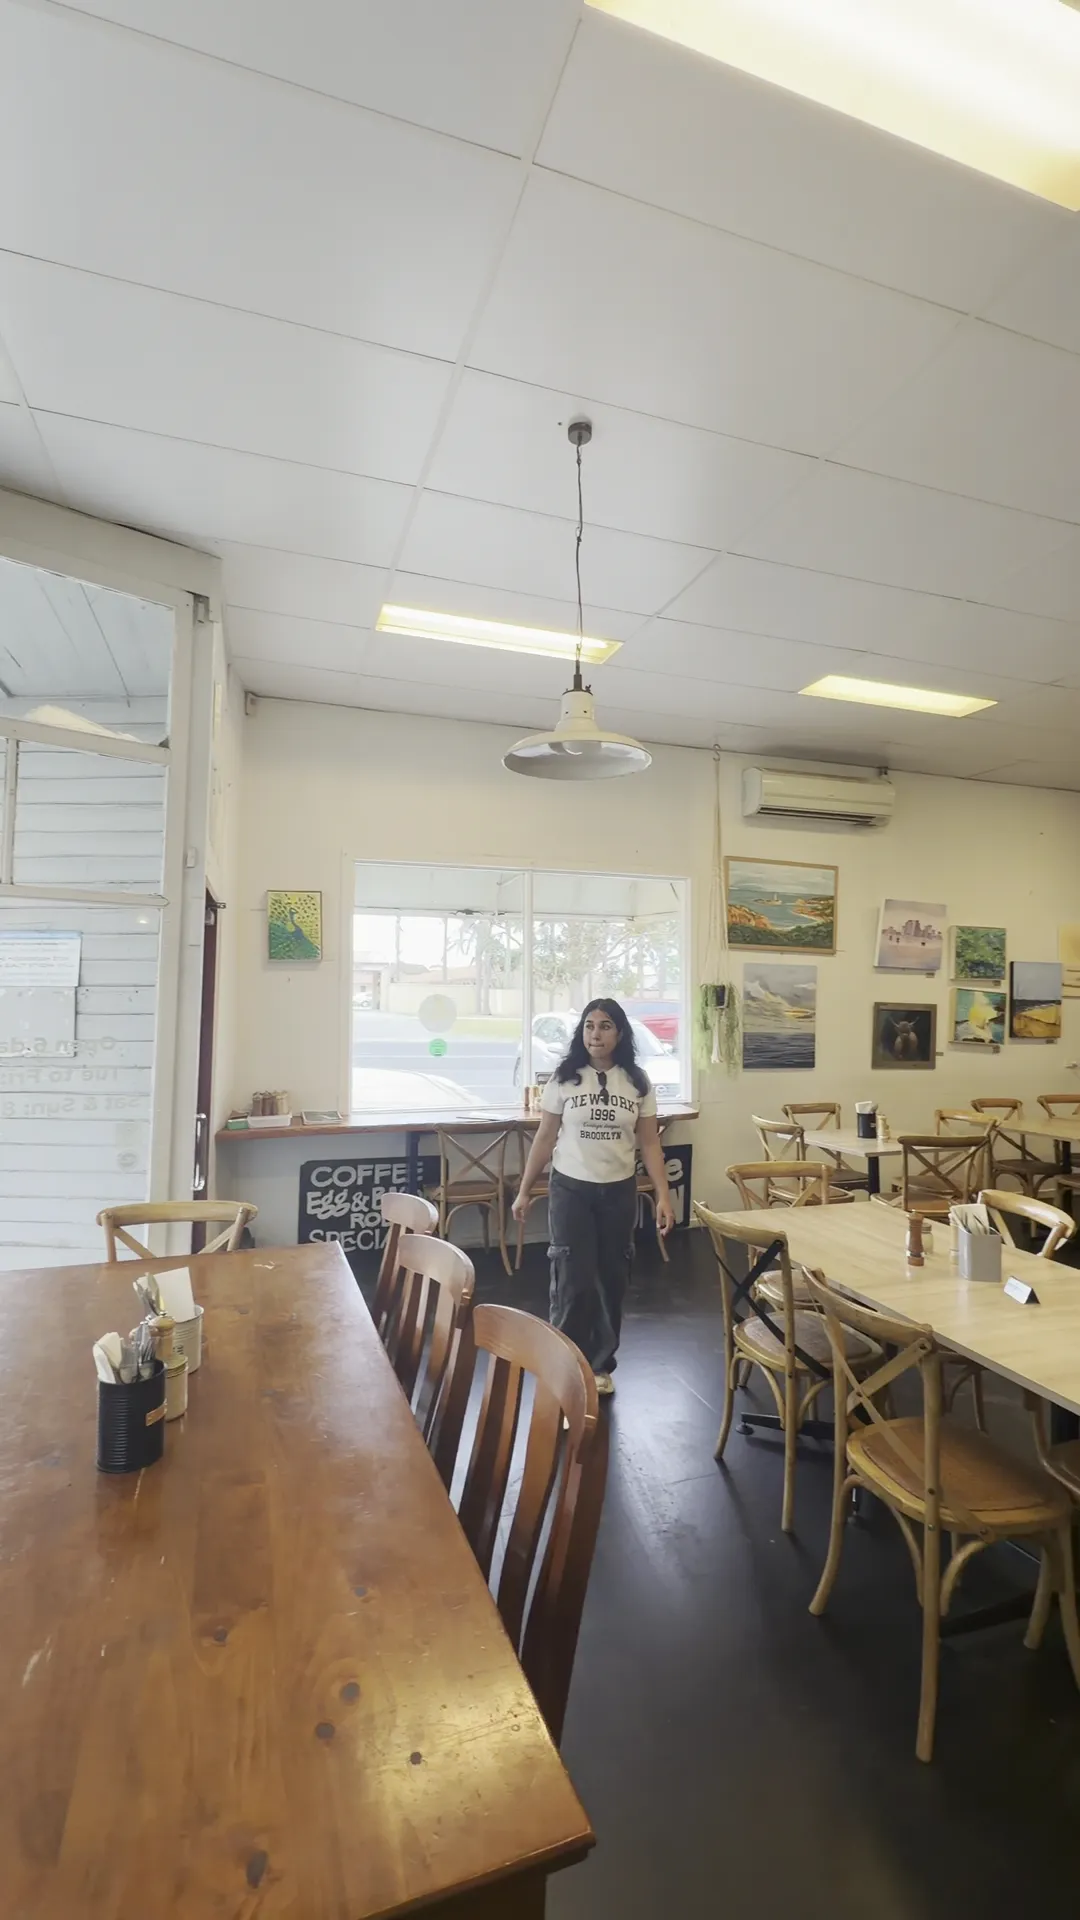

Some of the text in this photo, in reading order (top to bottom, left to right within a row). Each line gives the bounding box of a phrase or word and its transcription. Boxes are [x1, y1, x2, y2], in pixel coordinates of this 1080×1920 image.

[570, 1093, 635, 1114] NEW ORK
[590, 1108, 616, 1121] 1996
[580, 1130, 622, 1140] BROOKLYN
[351, 1191, 370, 1212] &
